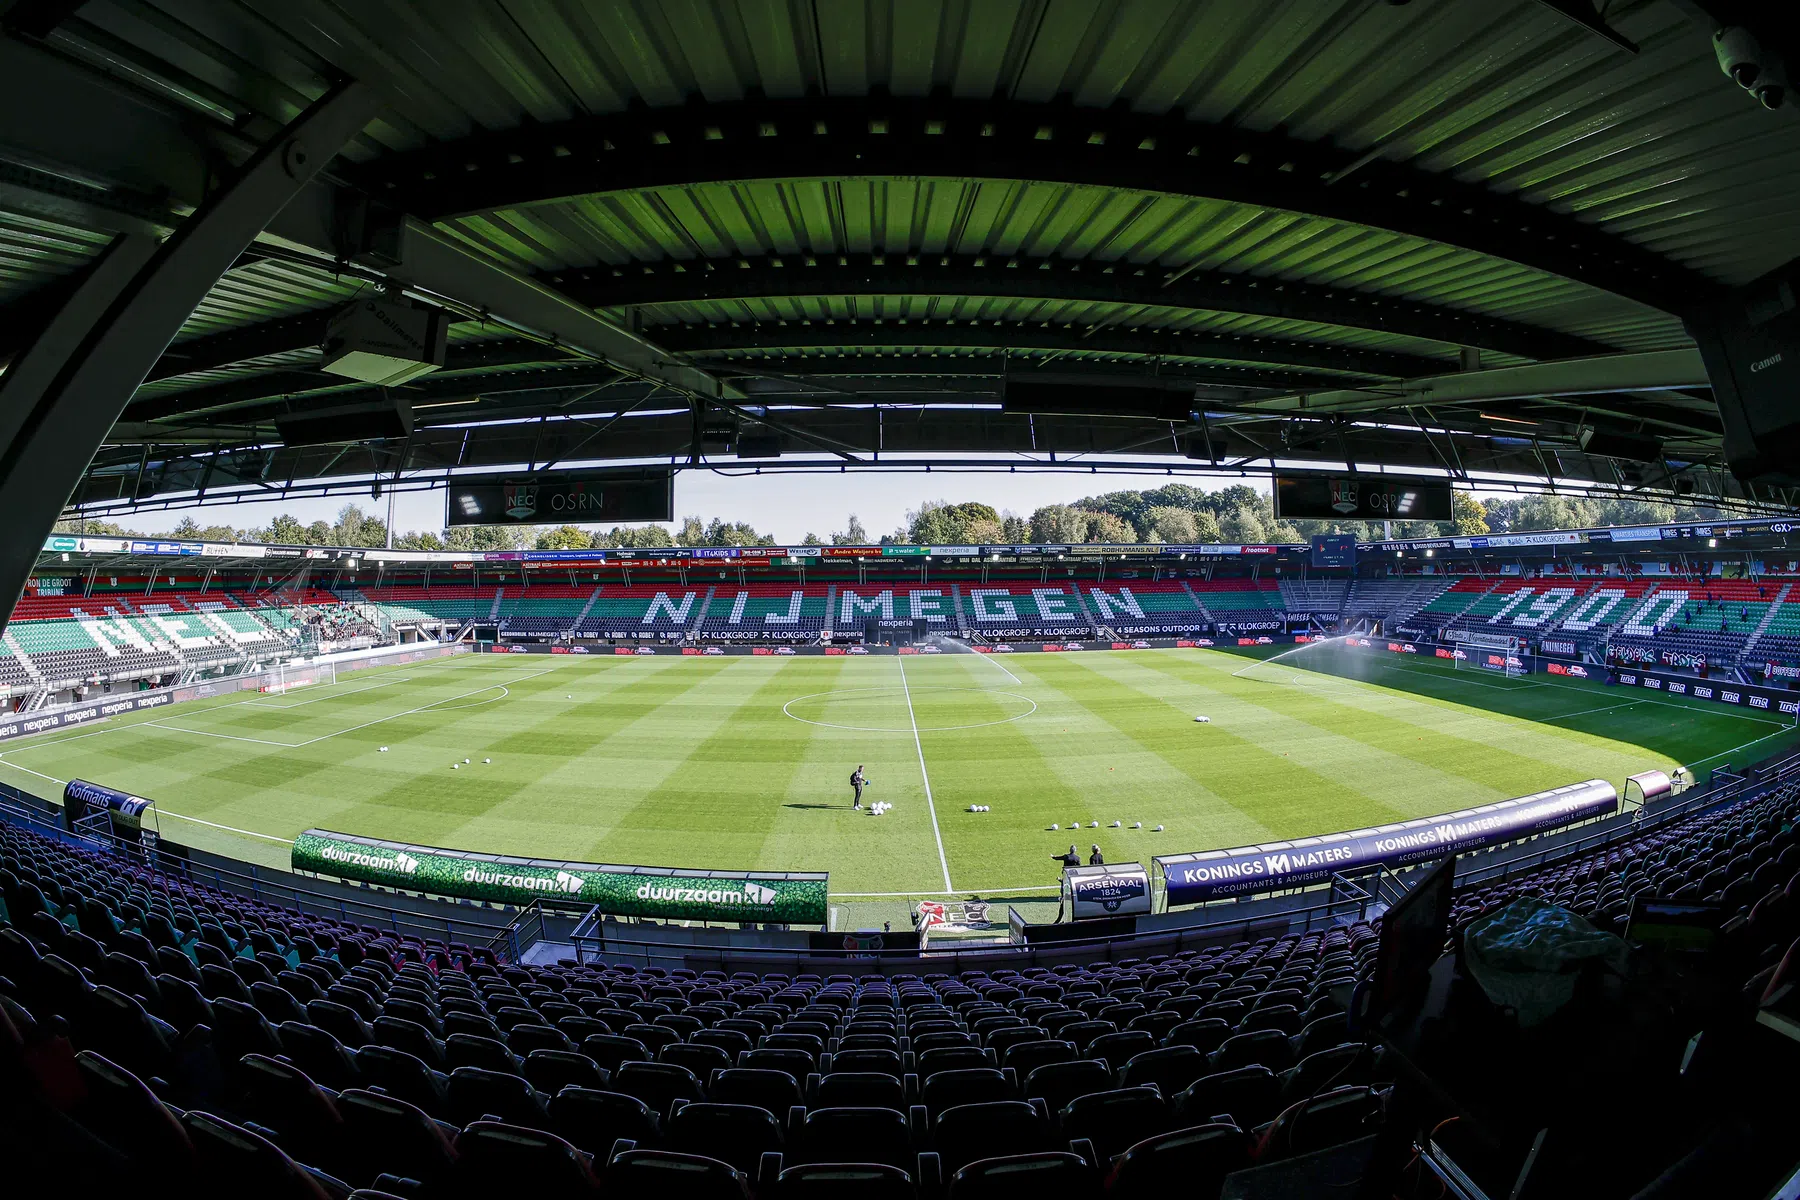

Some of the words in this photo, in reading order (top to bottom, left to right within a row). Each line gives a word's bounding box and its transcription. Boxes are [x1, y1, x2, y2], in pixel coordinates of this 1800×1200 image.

[1750, 353, 1782, 373] Canon
[508, 494, 534, 507] NEC
[551, 492, 604, 511] OSRN
[1333, 491, 1356, 502] NEC
[1531, 535, 1566, 543] KLOKGROEP
[27, 578, 40, 588] RON
[41, 578, 51, 588] DE
[51, 578, 72, 588] GROOT
[1487, 586, 1689, 636] 1900
[878, 619, 914, 629] nexperia
[1161, 624, 1200, 632] OUTDOOR
[1238, 621, 1281, 630] KLOKGROEP
[583, 631, 598, 639] ROBEY
[611, 631, 627, 639] ROBEY
[638, 631, 655, 639] ROBEY
[711, 631, 759, 639] KLOKGROEP
[772, 631, 820, 639] KLOKGROEP
[833, 630, 863, 638] nexperia
[929, 629, 958, 638] nexperia
[982, 628, 1031, 637] KLOKGROEP
[1043, 627, 1090, 636] KLOKGROEP
[1545, 641, 1575, 653] NIJMEGEN
[137, 693, 168, 707] nexperia
[101, 700, 133, 715] nexperia
[64, 707, 97, 723] nexperia
[23, 715, 59, 732] nexperia
[67, 781, 112, 808] hofmans
[1535, 815, 1570, 829] ACCOUNTANTS
[1576, 805, 1600, 817] ADVISEURS
[1375, 830, 1436, 853] KONINGS
[1455, 816, 1503, 836] MATERS
[1398, 847, 1445, 862] ACCOUNTANTS
[1453, 836, 1486, 850] ADVISEURS
[1183, 860, 1264, 884] KONINGS
[1292, 846, 1353, 868] MATERS
[1079, 879, 1142, 893] ARSENAAL
[1211, 878, 1274, 895] ACCOUNTANTS
[1277, 877, 1283, 885] &
[1286, 869, 1329, 883] ADVISEURS
[1100, 888, 1121, 896] 1824
[929, 911, 983, 922] NEC
